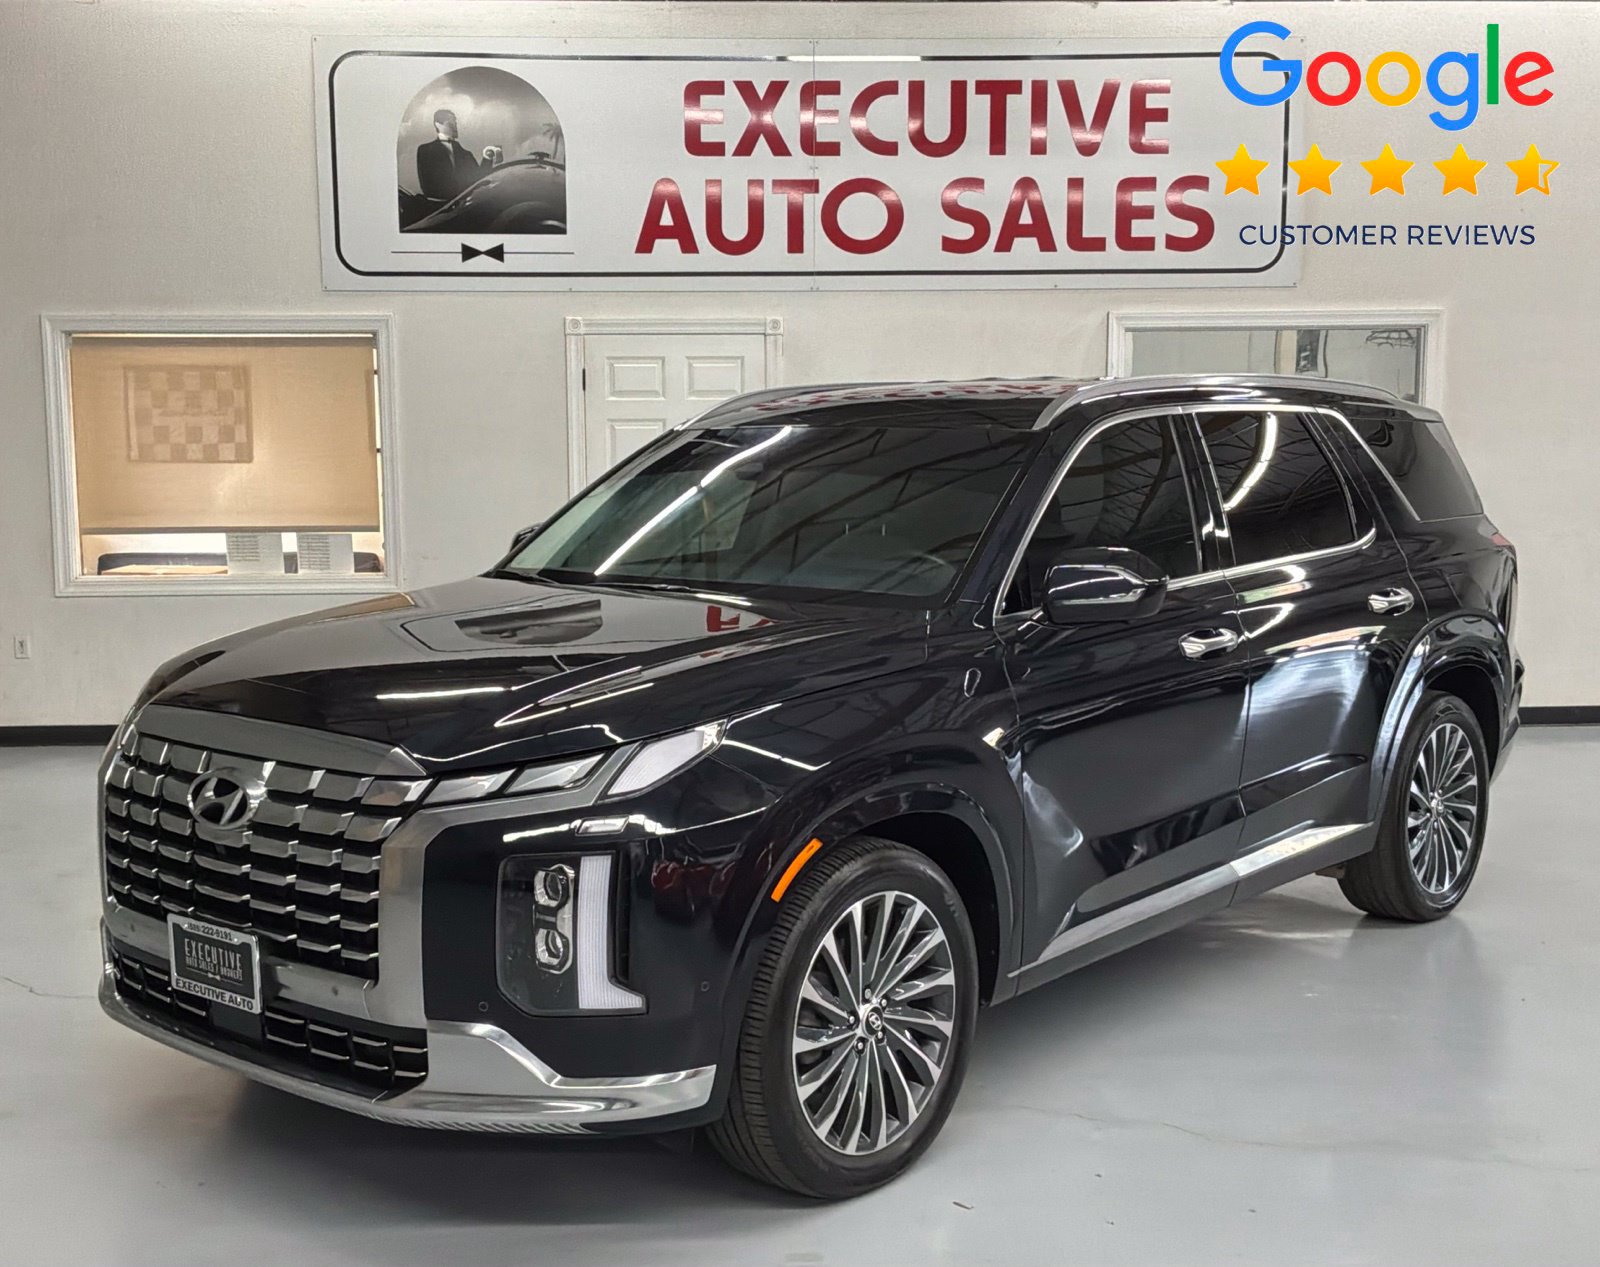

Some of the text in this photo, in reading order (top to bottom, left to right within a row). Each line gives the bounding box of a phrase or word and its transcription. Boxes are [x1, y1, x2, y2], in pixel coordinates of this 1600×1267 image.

[683, 78, 1172, 158] EXECUTIVE
[634, 175, 1215, 256] AUTO SALES
[184, 938, 242, 971] EXECUTIVE
[175, 978, 254, 1010] EXECUTIVE AUTO
